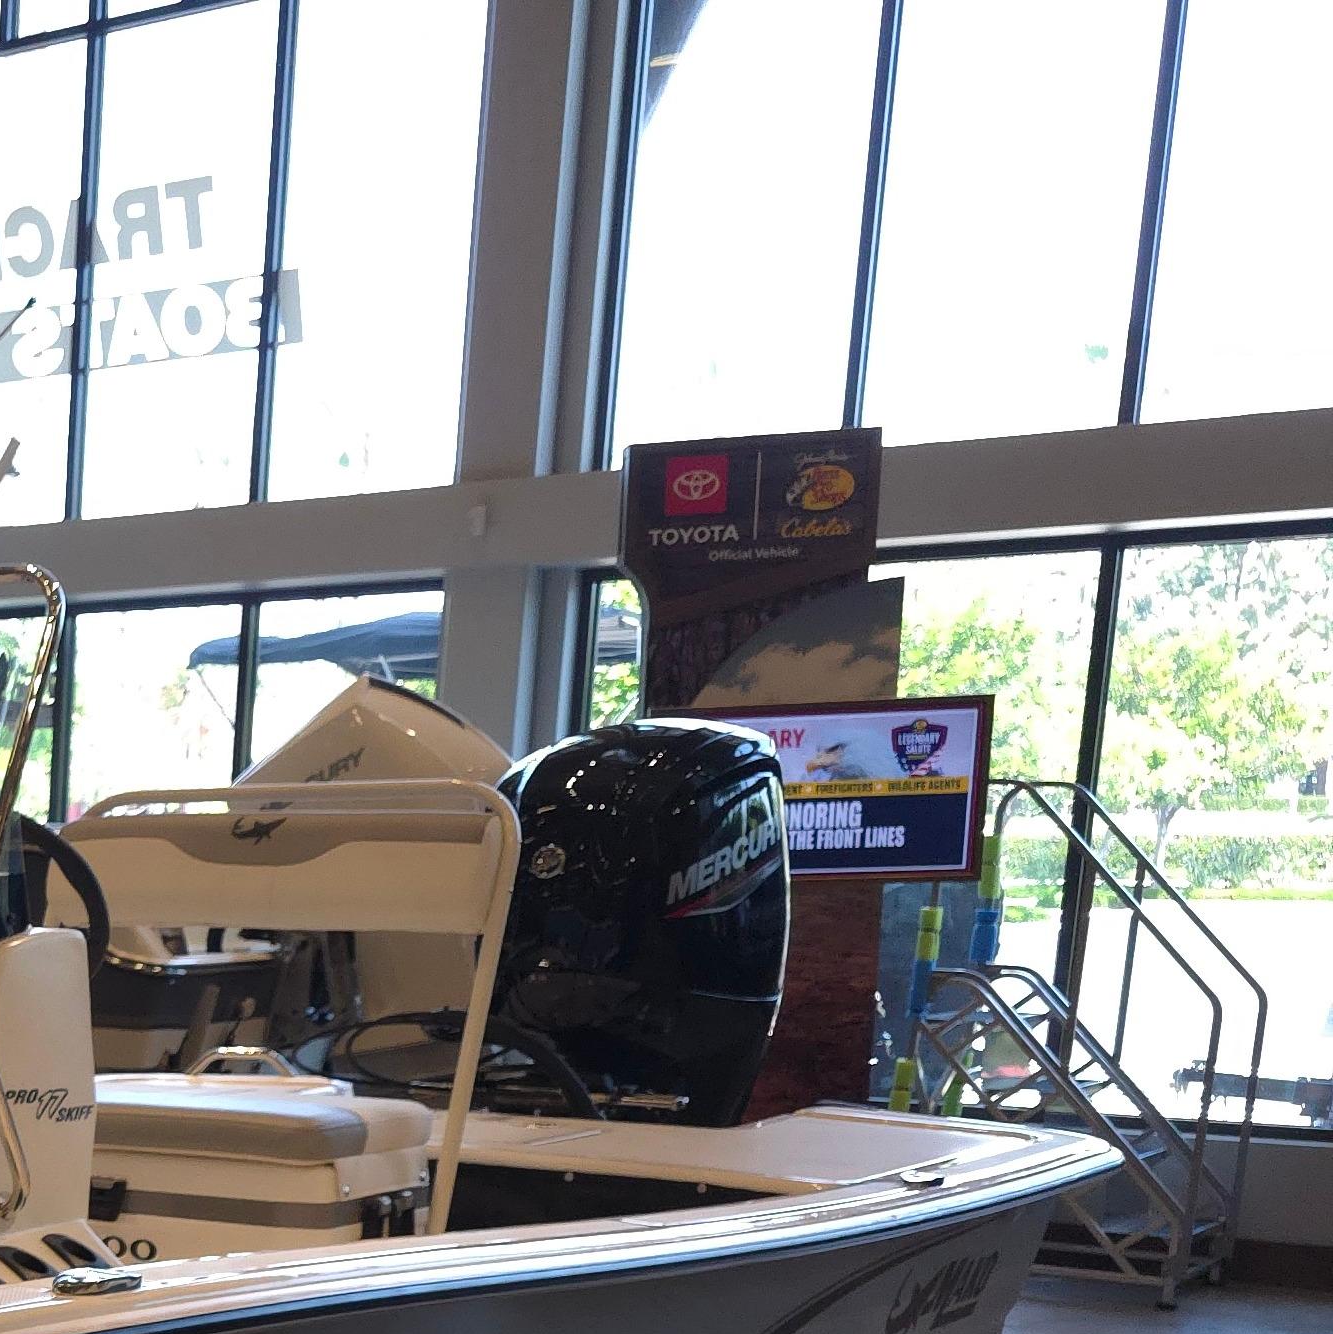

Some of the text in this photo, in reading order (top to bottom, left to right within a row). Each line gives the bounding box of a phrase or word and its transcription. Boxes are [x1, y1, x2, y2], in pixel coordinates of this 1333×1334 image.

[649, 524, 740, 547] TOYOTA
[709, 545, 799, 561] Official Vehicle
[928, 775, 962, 791] AGENTS
[784, 799, 863, 831] NORING
[816, 827, 863, 849] FRONT
[864, 824, 906, 849] LINES
[666, 818, 781, 906] MERCUR
[4, 1088, 94, 1123] PRO 17 SKIFF
